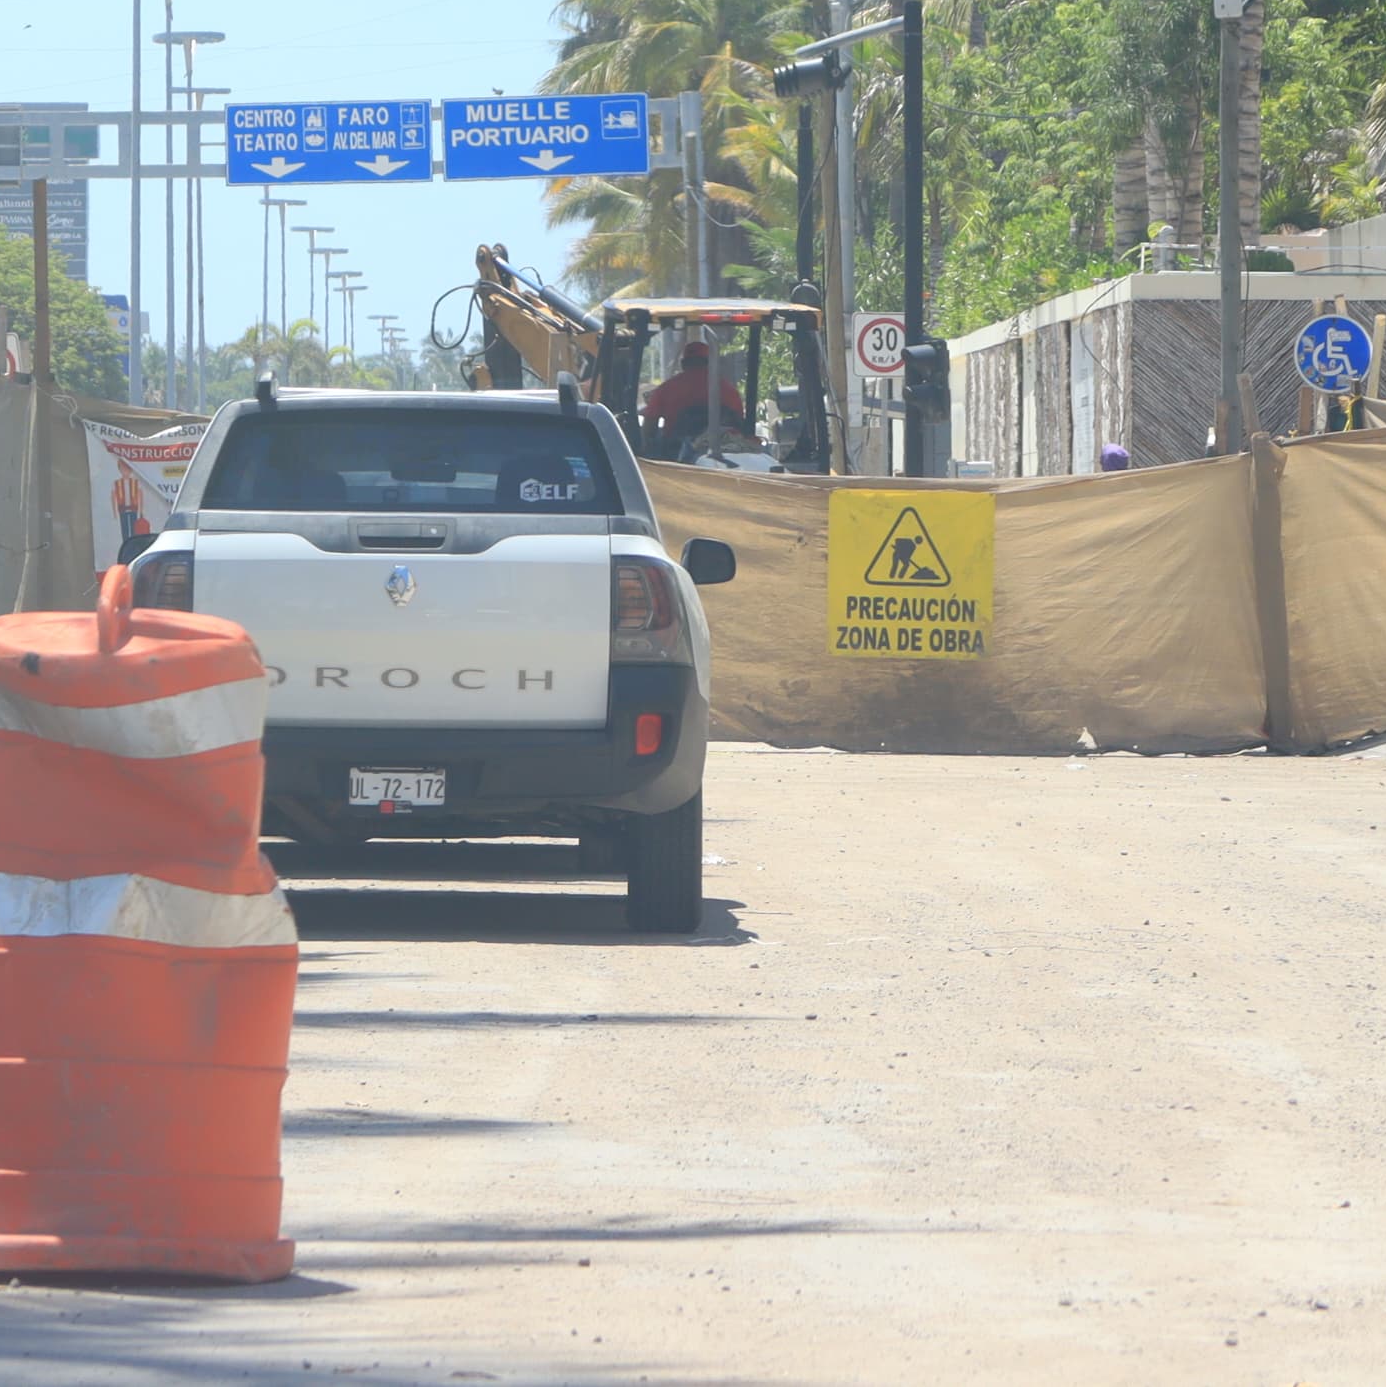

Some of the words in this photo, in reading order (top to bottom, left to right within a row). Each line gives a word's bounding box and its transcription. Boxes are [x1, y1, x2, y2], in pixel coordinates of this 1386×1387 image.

[234, 109, 296, 128] CENTRO
[338, 106, 389, 126] FARO
[466, 101, 571, 123] MUELLE
[234, 132, 298, 152] TEATRO
[373, 130, 396, 149] MAR
[451, 124, 590, 147] PORTUARIO
[872, 327, 898, 351] 30
[846, 593, 976, 622] PRECAUCIÓN
[836, 626, 891, 651] ZONA
[897, 628, 923, 651] DE
[929, 628, 985, 654] OBRA
[350, 777, 445, 799] UL-72-172
